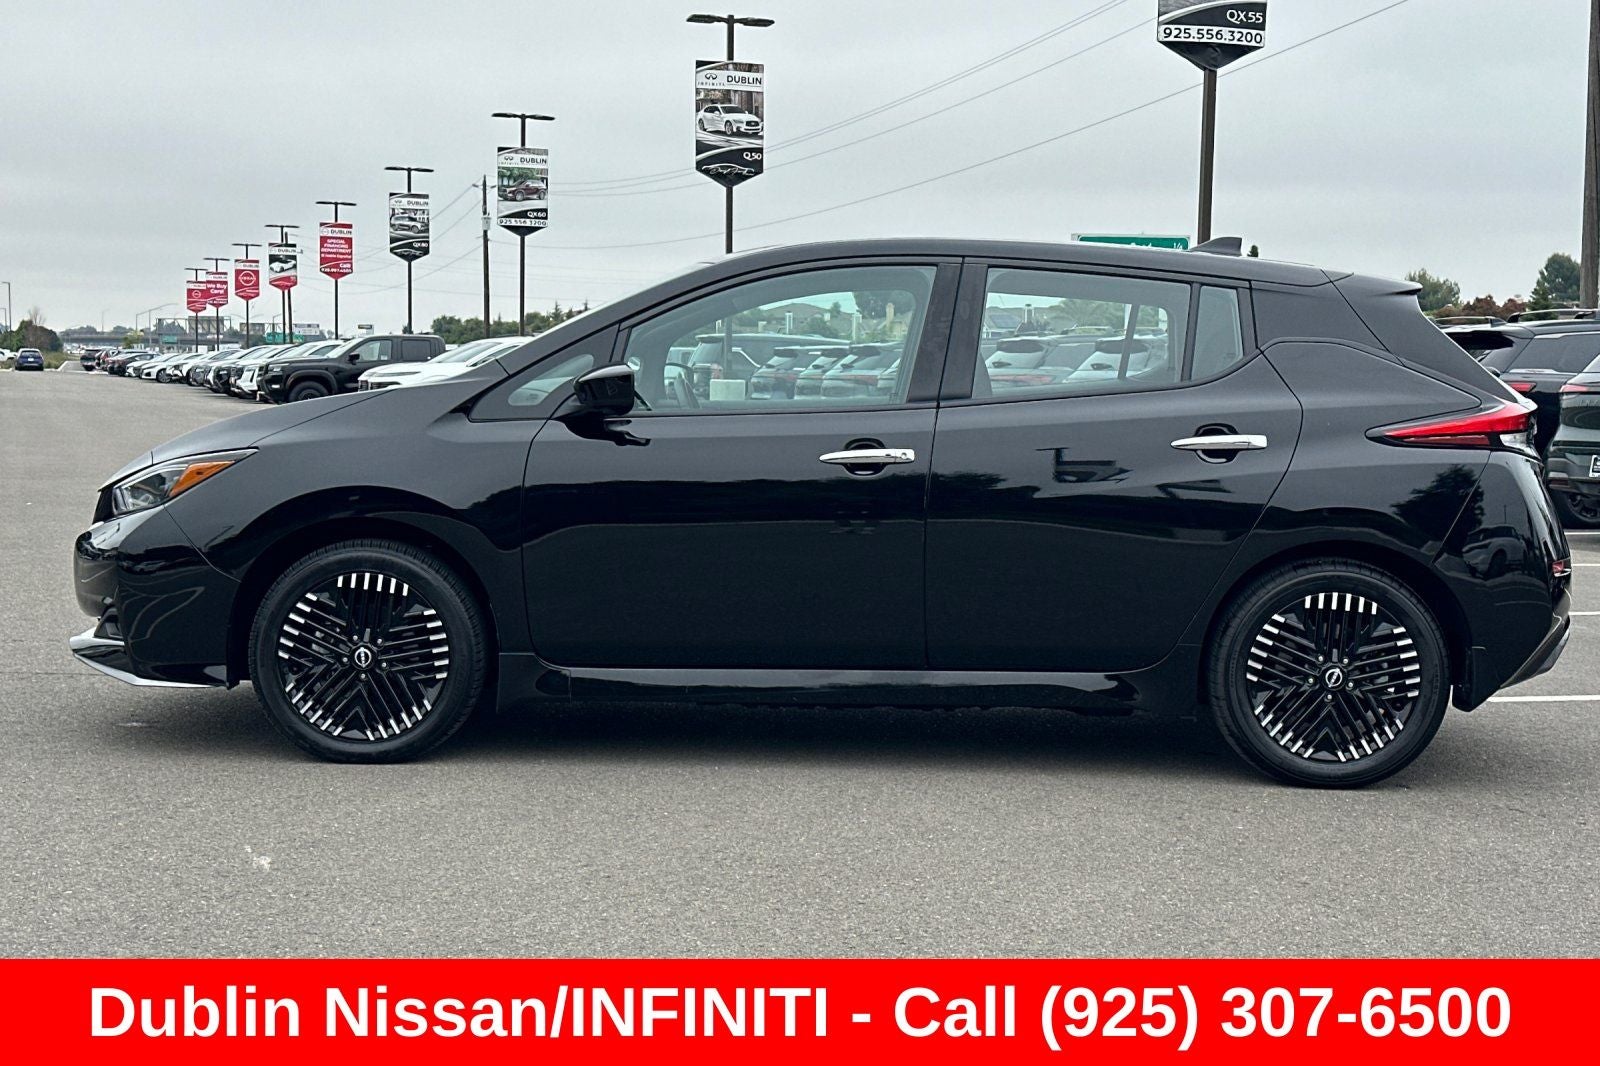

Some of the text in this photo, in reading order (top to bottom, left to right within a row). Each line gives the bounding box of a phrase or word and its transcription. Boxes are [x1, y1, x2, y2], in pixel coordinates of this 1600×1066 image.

[1226, 9, 1263, 24] QX55
[1163, 27, 1263, 43] 925.556.3200
[726, 74, 762, 85] DUBLIN
[519, 156, 547, 164] DUBLIN
[743, 151, 762, 161] Q50
